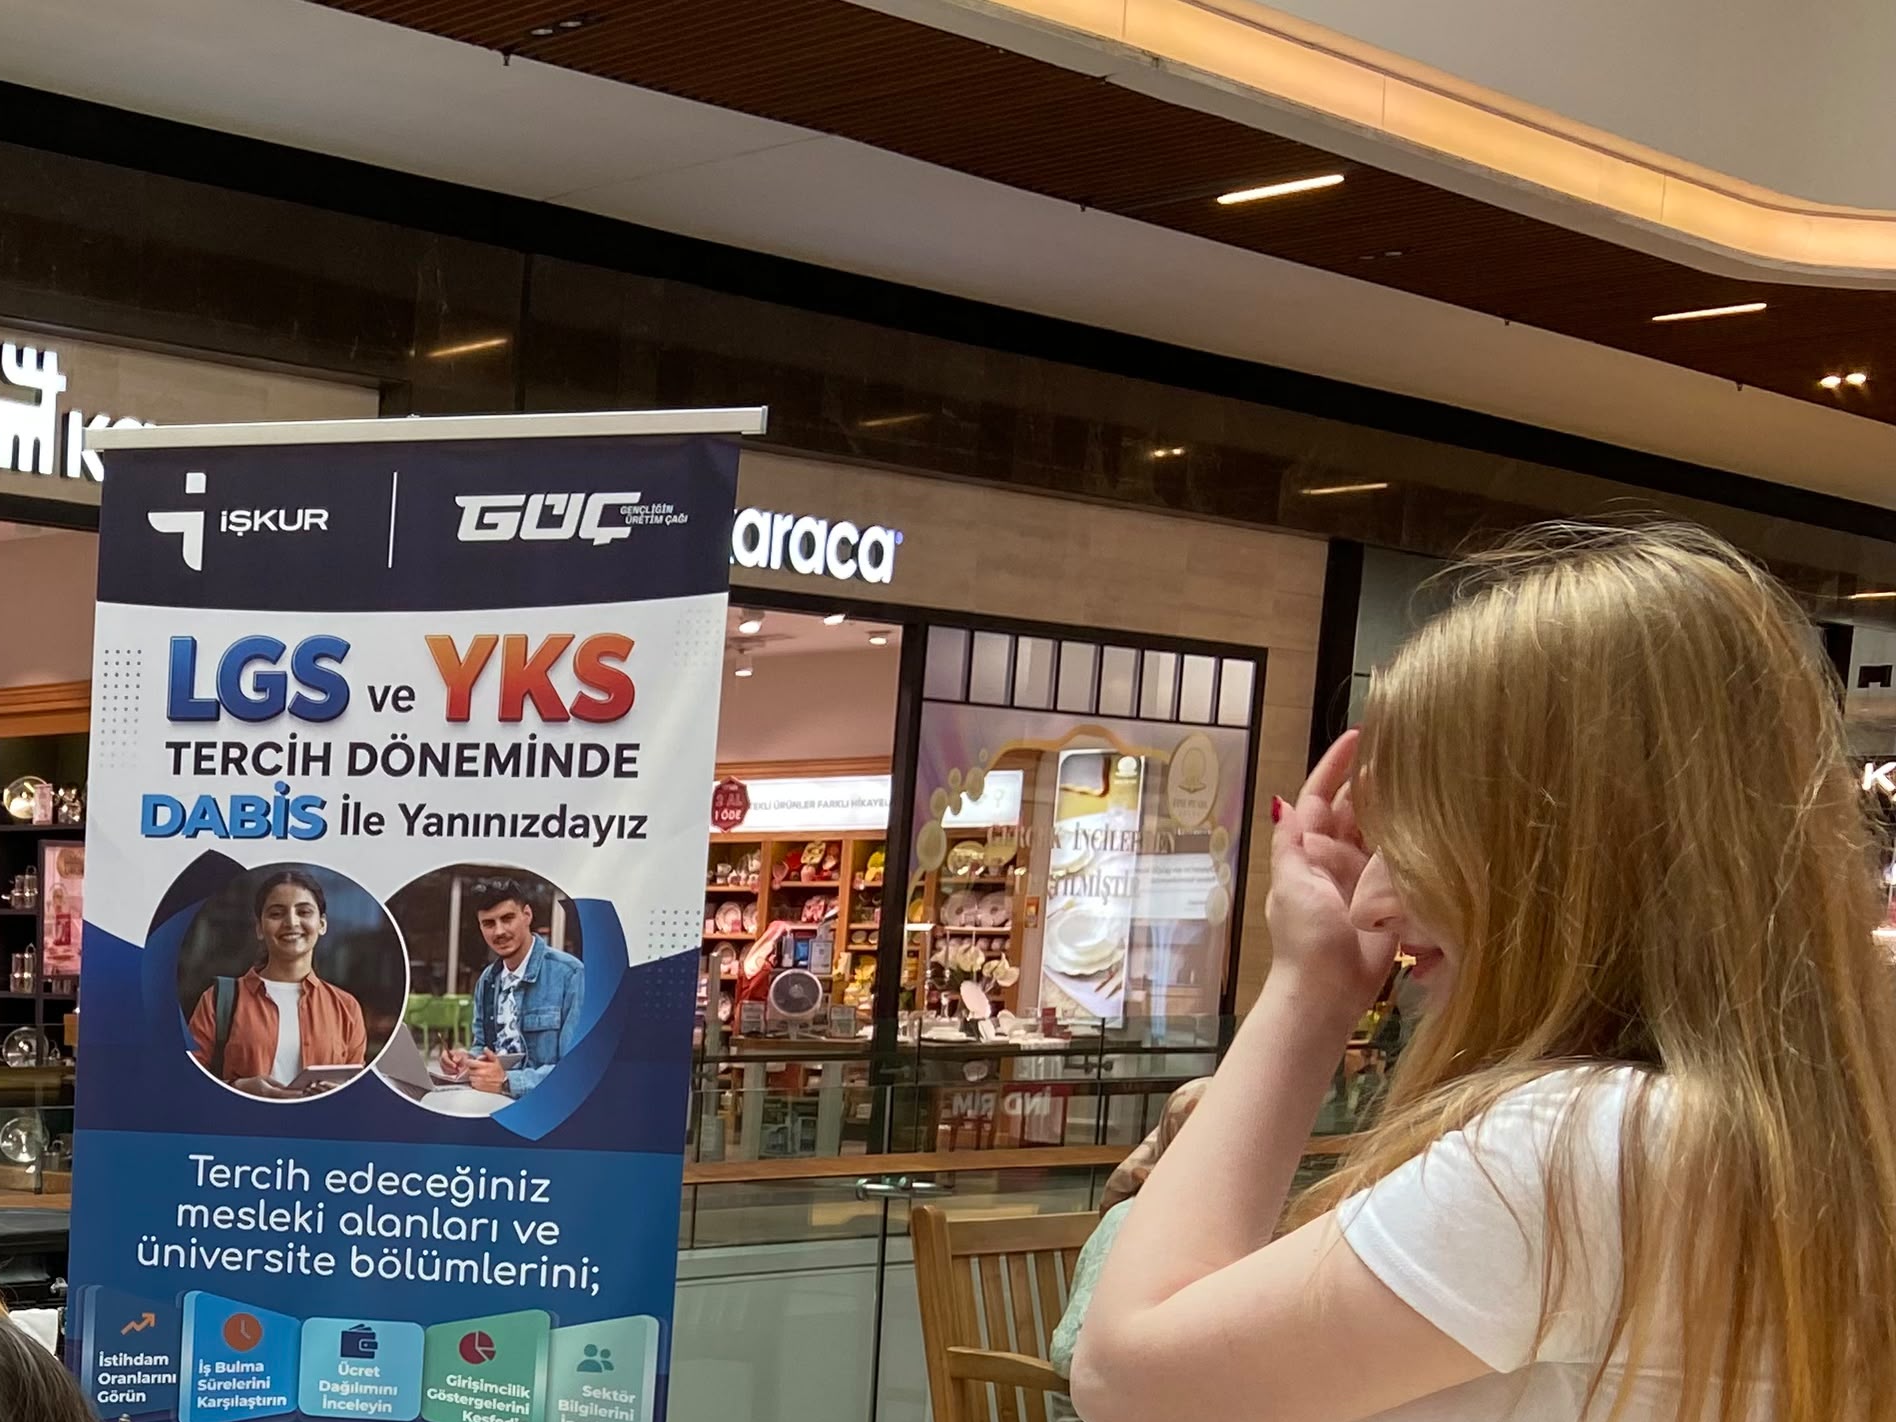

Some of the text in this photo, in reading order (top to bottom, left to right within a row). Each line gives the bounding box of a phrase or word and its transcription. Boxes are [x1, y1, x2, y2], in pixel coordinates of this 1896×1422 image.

[730, 508, 896, 585] araca
[166, 633, 637, 723] LGS ve YKS
[165, 732, 641, 779] TERCİH DÖNEMİNDE
[140, 780, 648, 848] DABİS İle Yanınızdayız
[188, 1153, 551, 1208] Tercih edeceğiniz
[176, 1199, 560, 1246] mesleki alanları ve
[137, 1234, 600, 1297] üniversite bölümlerini;
[98, 1351, 170, 1368] İstihdam
[198, 1359, 265, 1376] İş Bulma
[338, 1361, 380, 1378] Ücret
[98, 1371, 177, 1386] Oranlarını
[197, 1376, 271, 1392] Sürelerini
[319, 1379, 398, 1398] Dağılımını
[445, 1373, 531, 1400] Girişimcilik
[97, 1389, 147, 1404] Görün
[197, 1394, 288, 1411] Karşılaştırın
[322, 1394, 393, 1414] İnceleyin
[426, 1388, 530, 1416] Göstergelerini
[582, 1385, 636, 1404] Sektör
[558, 1399, 635, 1422] Bilgilerini
